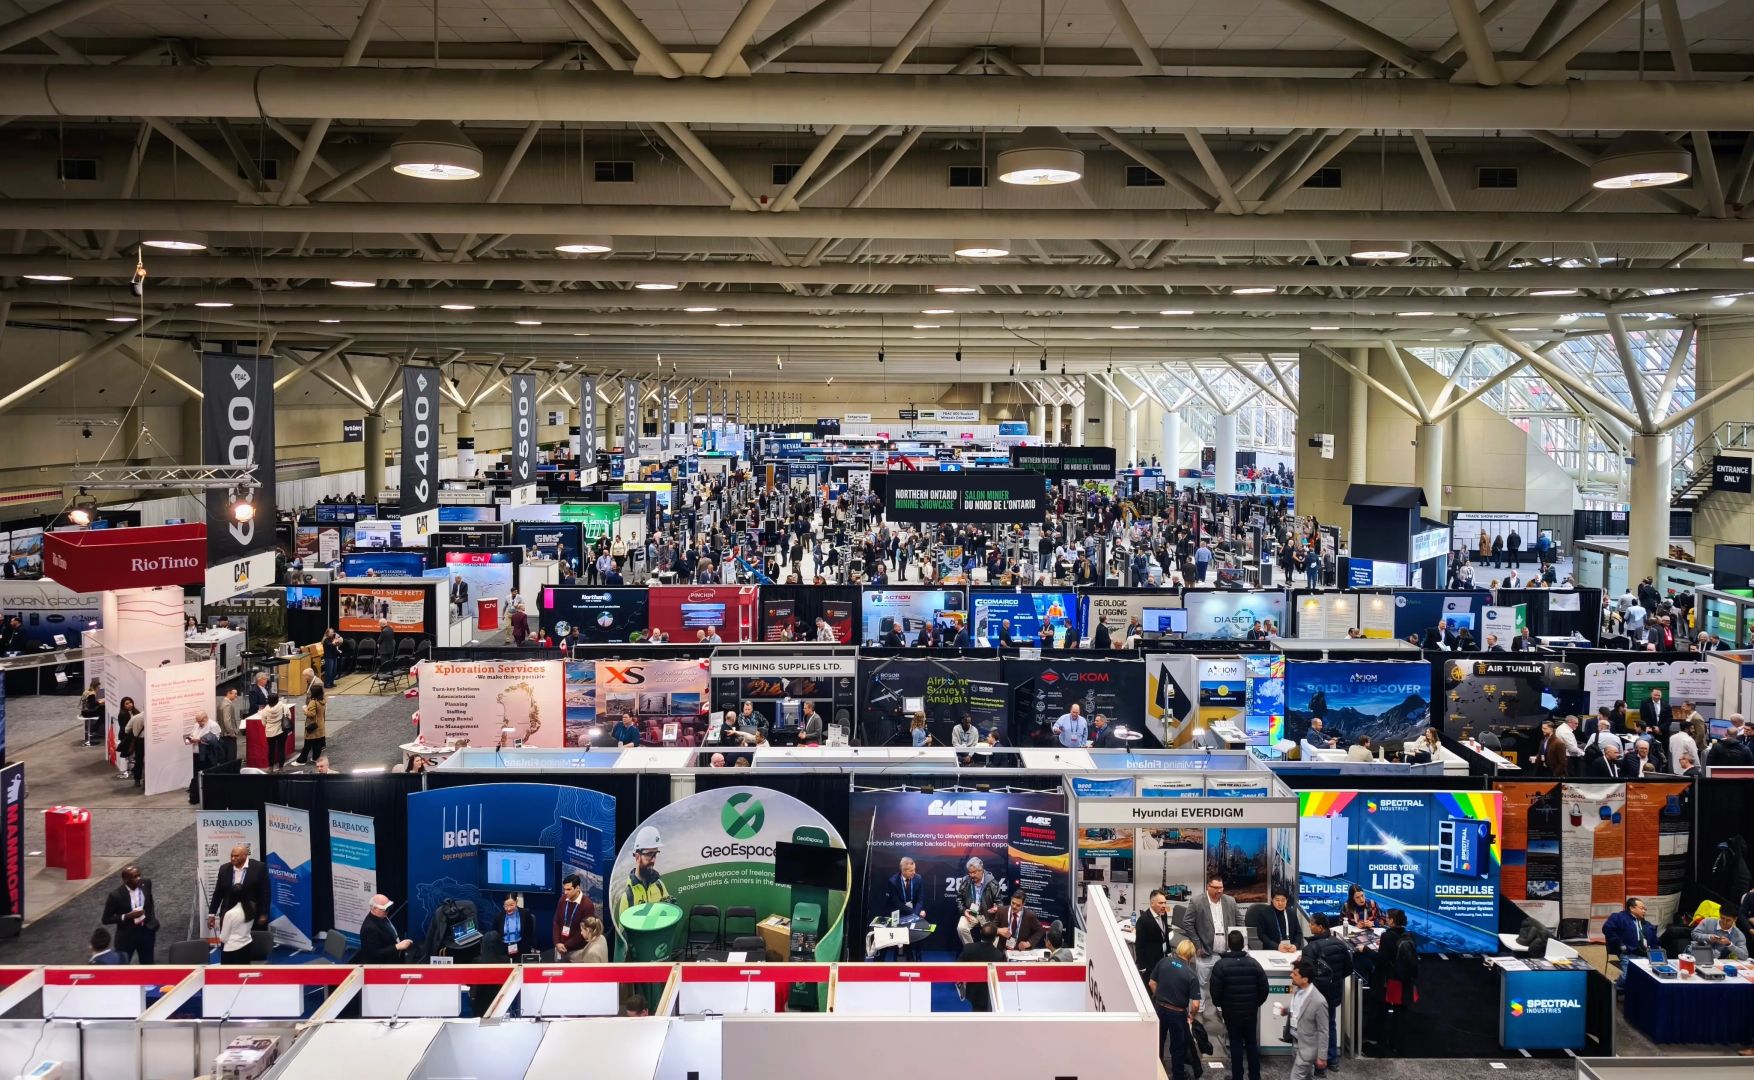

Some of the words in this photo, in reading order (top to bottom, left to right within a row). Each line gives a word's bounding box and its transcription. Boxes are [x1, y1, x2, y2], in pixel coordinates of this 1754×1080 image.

[518, 396, 529, 480] 6500
[414, 396, 430, 503] 6400
[1717, 465, 1749, 474] ENTRANCE
[1724, 474, 1741, 483] ONLY
[895, 489, 928, 499] NORTHERN
[930, 490, 957, 500] ONTARIO
[964, 491, 986, 500] SALON
[987, 491, 1009, 500] MINIER
[895, 500, 919, 509] MINING
[920, 500, 954, 509] SHOWCASE
[964, 500, 974, 509] DU
[975, 501, 993, 510] NORD
[994, 501, 1001, 510] DE
[1003, 500, 1035, 510] L'ONTARIO
[416, 515, 428, 534] CAT
[534, 534, 559, 543] GMS
[234, 561, 250, 583] CAT
[51, 597, 98, 606] GROUP
[435, 665, 495, 675] Xploration
[498, 664, 546, 673] Services
[606, 666, 645, 684] XS
[1307, 684, 1352, 693] BOLDLY
[1359, 684, 1421, 693] DISCOVER
[1132, 808, 1178, 819] Hyundai
[1181, 808, 1244, 817] EVERDIGM
[203, 819, 252, 828] BARBADOS
[269, 822, 303, 832] BARBADOS
[332, 820, 369, 833] BARBADOS
[444, 828, 480, 849] BGC
[701, 870, 740, 879] Workspace
[678, 879, 722, 894] geoscientists
[1372, 874, 1415, 890] LIBS
[1435, 885, 1494, 894] COREPULSE
[1526, 999, 1580, 1008] SPECTRAL
